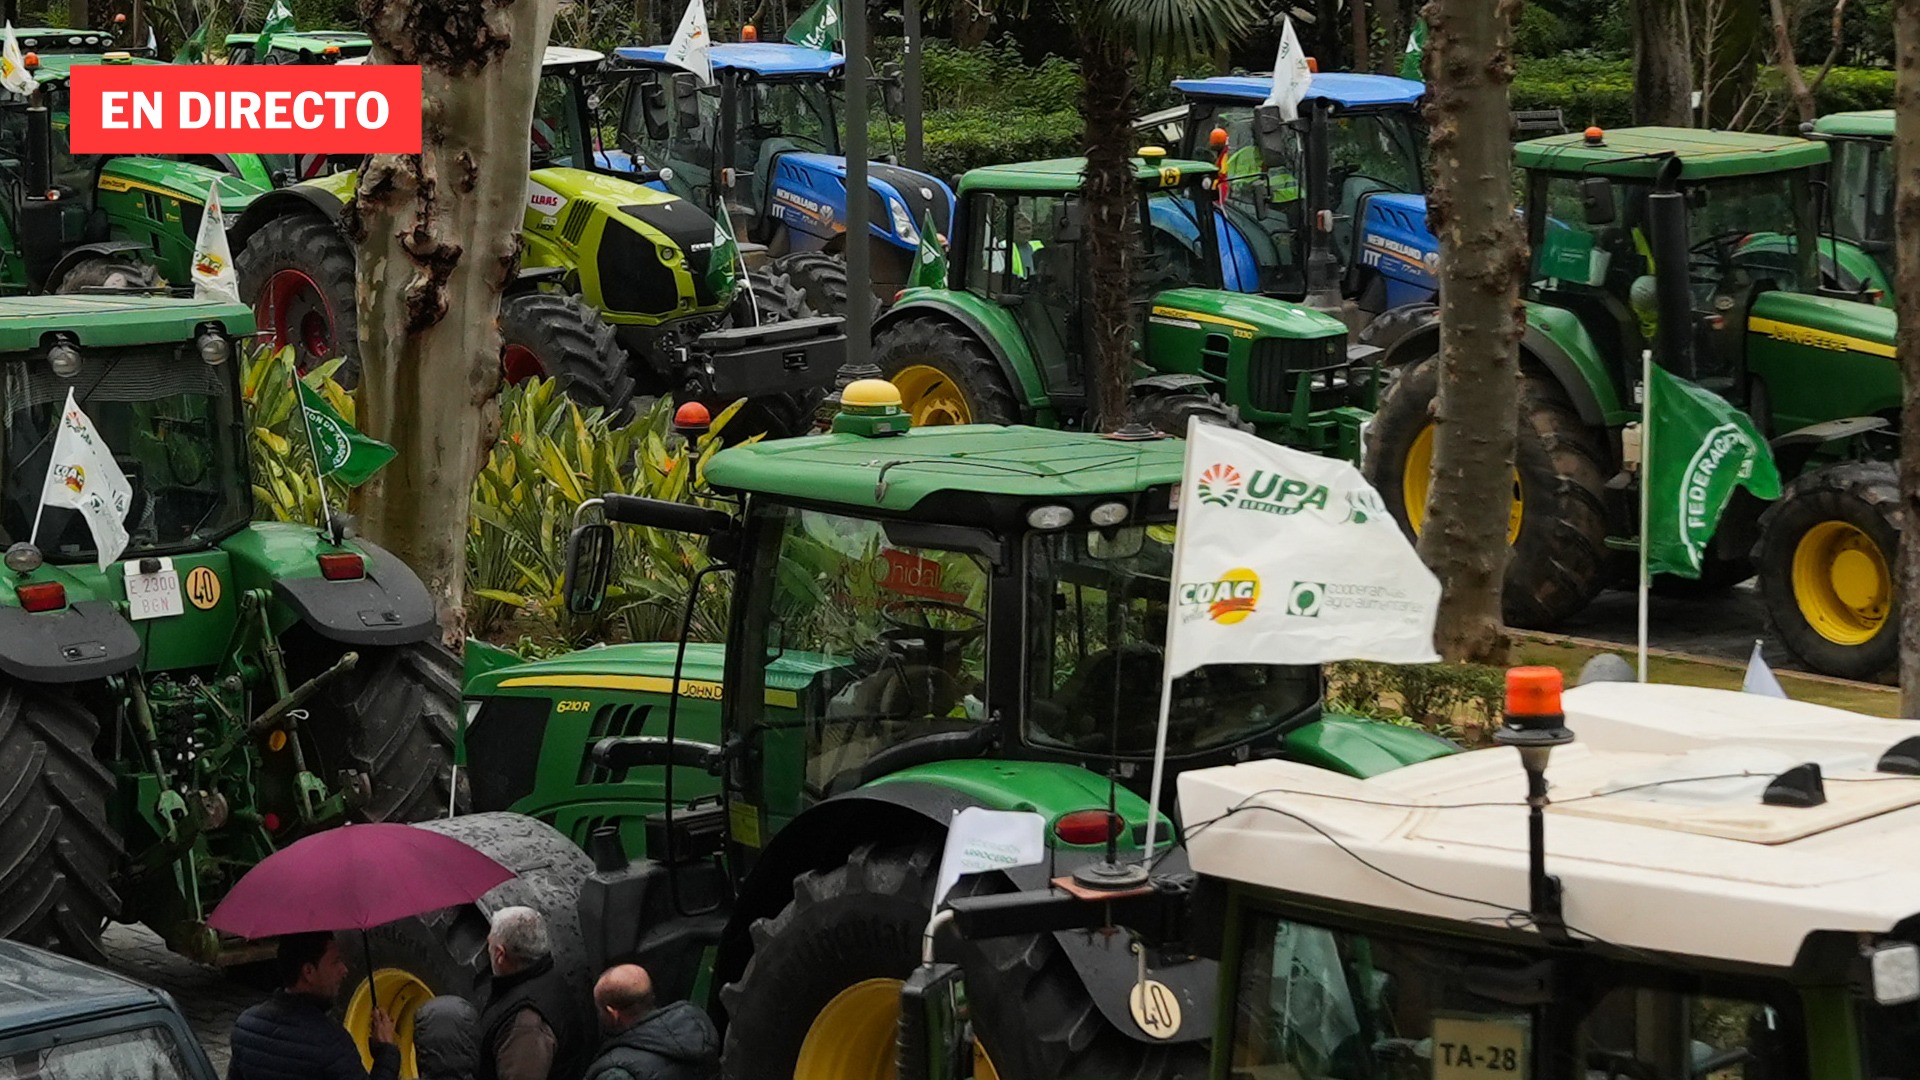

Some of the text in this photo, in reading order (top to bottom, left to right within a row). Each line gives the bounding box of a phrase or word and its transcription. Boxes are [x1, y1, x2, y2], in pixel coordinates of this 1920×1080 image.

[531, 194, 558, 207] CLAAS
[1246, 469, 1330, 510] UPA
[129, 576, 176, 595] E 2300
[194, 570, 214, 604] 40
[1180, 580, 1256, 606] COAG
[683, 684, 712, 697] JOHN
[1141, 984, 1172, 1030] 40
[1439, 1043, 1517, 1072] TA-28
